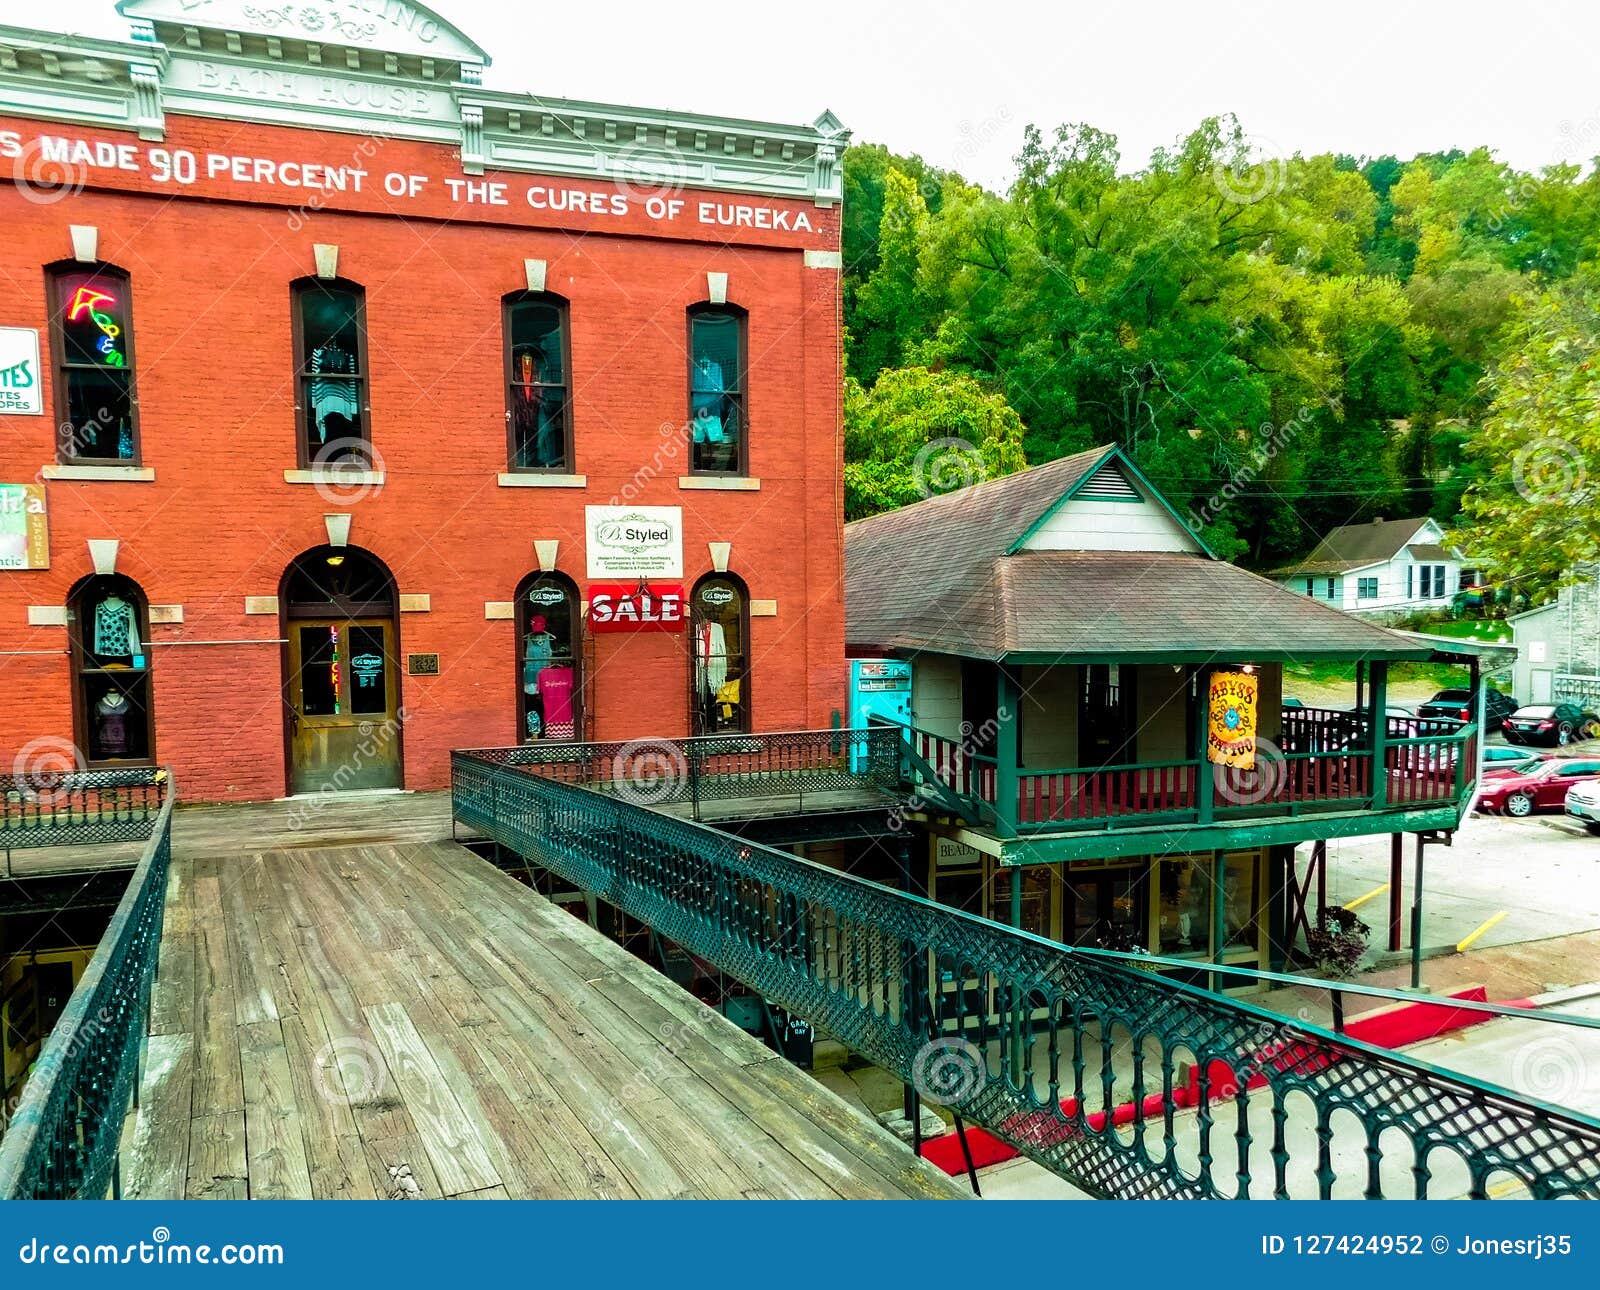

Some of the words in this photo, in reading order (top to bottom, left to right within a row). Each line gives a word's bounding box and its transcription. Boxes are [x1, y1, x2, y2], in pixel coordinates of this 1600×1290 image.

[196, 61, 299, 99] BATH
[318, 73, 432, 114] HOUSE
[42, 136, 140, 172] MADE
[149, 150, 197, 185] 90
[207, 154, 368, 192] PERCENT
[384, 173, 429, 198] OF
[444, 178, 508, 206] THE
[526, 186, 630, 217] CURES
[645, 197, 685, 221] OF
[625, 528, 668, 543] Styled
[591, 594, 681, 622] SALE
[1211, 680, 1255, 705] ABYSS
[1208, 731, 1254, 757] TATTOO
[790, 1019, 809, 1029] GAME
